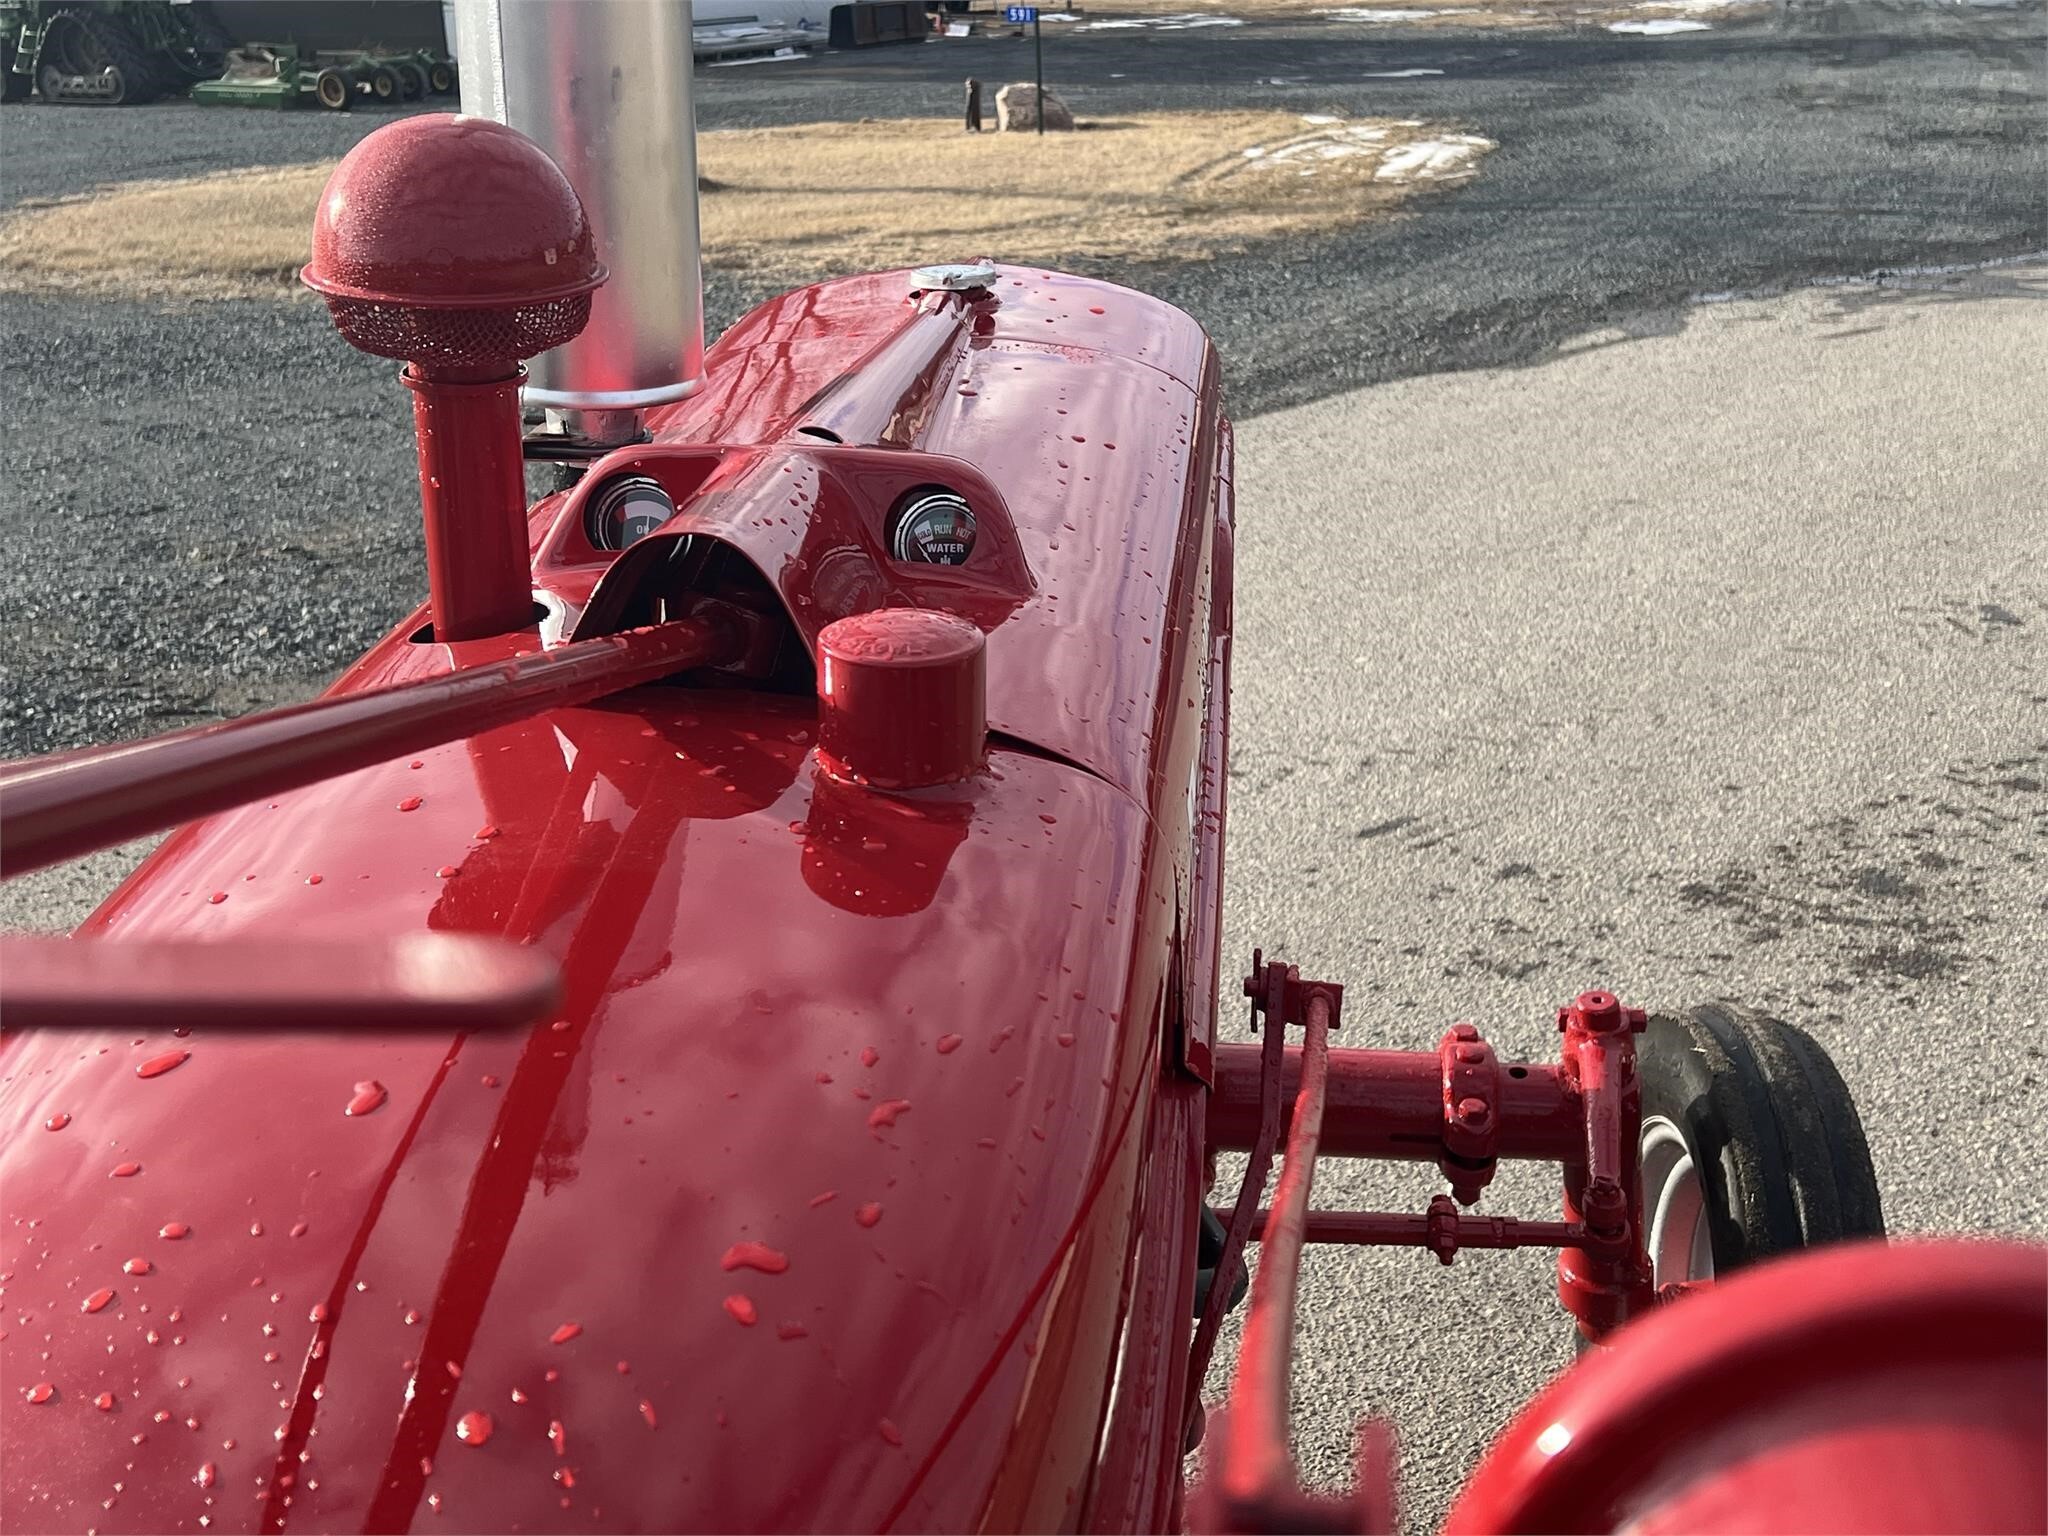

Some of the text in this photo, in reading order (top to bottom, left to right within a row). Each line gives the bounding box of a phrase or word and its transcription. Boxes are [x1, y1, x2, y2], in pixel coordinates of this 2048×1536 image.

[1009, 8, 1031, 21] 591
[934, 524, 952, 535] RUN
[956, 527, 971, 540] HOT
[926, 543, 964, 553] WATER
